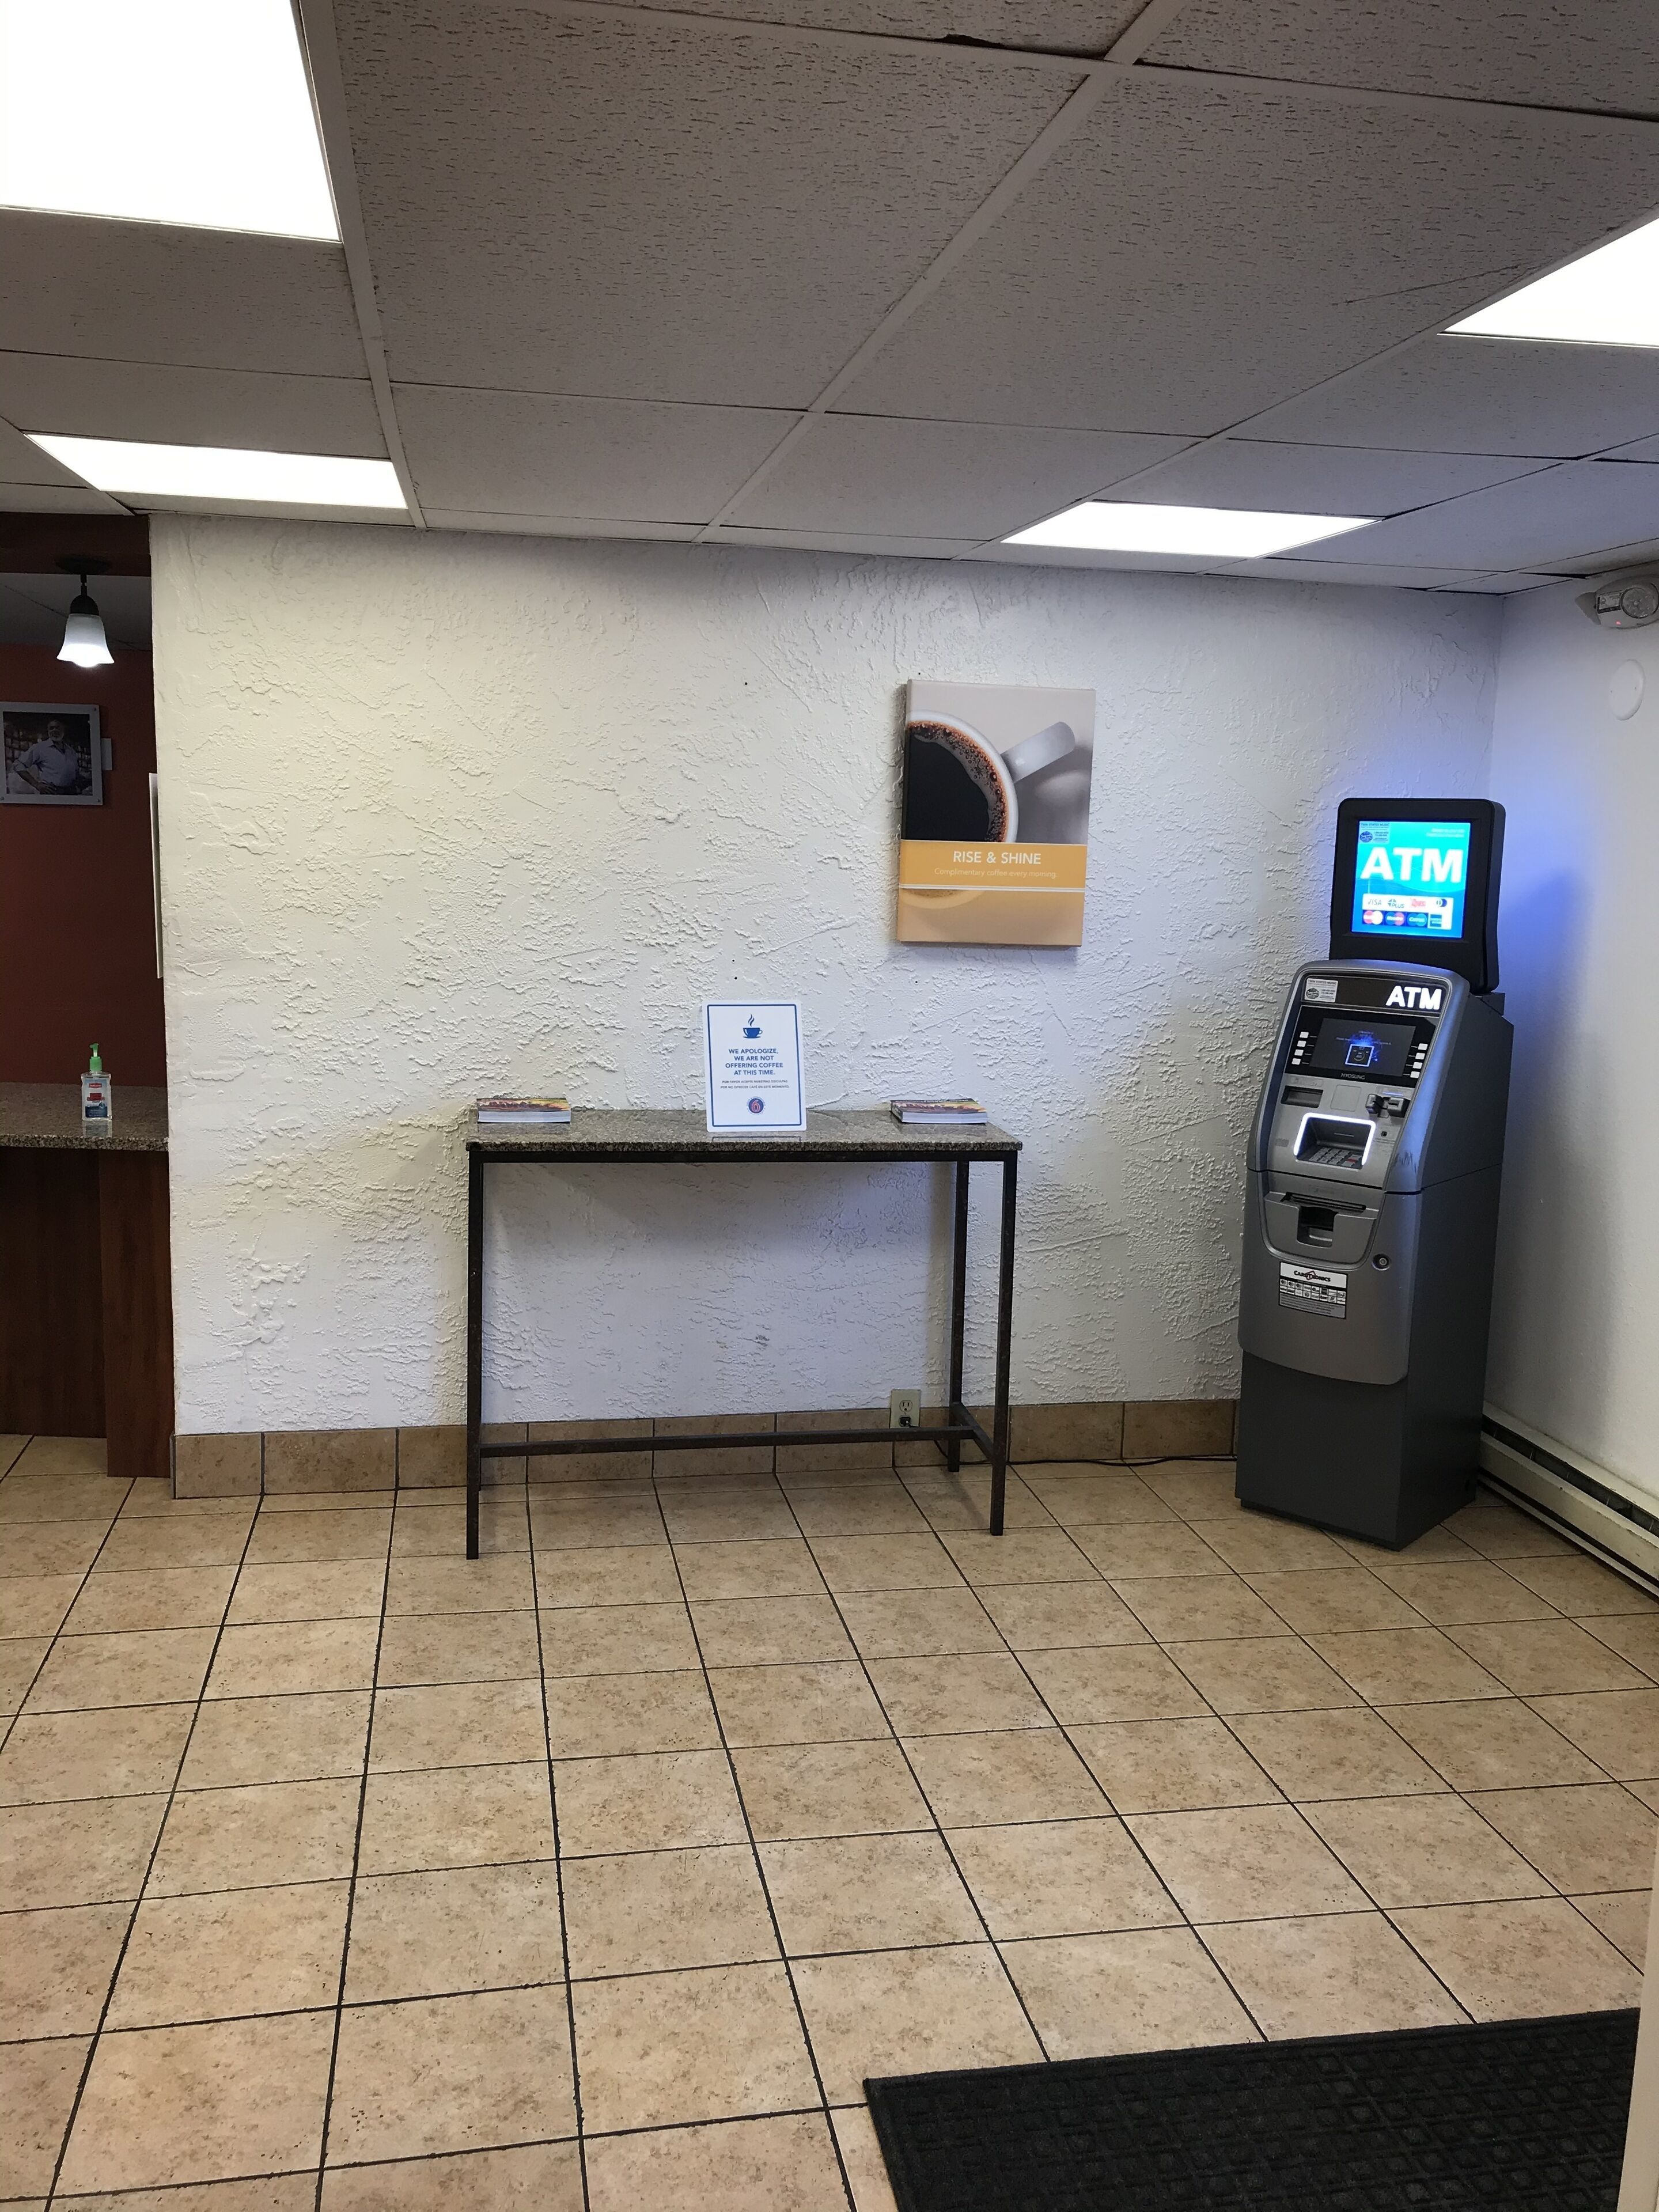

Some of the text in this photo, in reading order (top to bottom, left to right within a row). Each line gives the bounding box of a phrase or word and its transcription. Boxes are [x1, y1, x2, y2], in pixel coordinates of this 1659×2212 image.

[953, 851, 1041, 865] RISE & SHINE
[1360, 846, 1464, 883] ATM
[934, 868, 985, 877] Complimentary
[1385, 985, 1442, 1010] ATM
